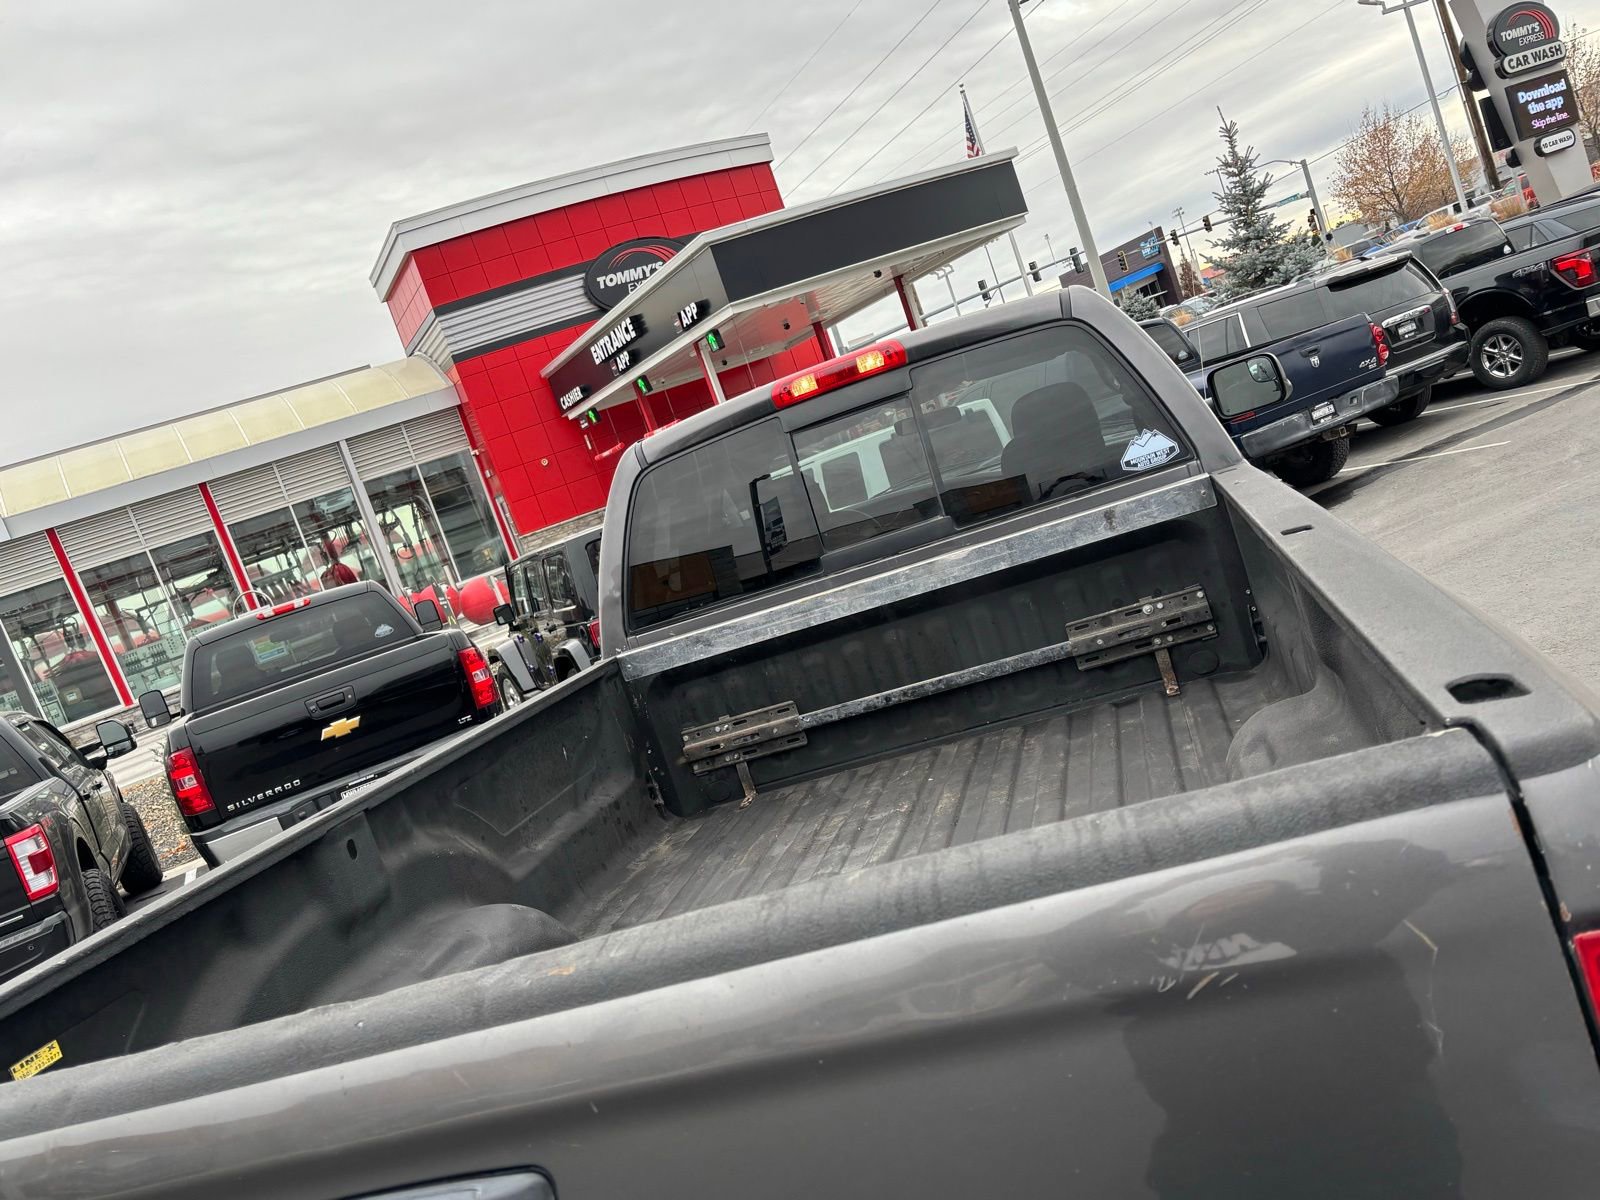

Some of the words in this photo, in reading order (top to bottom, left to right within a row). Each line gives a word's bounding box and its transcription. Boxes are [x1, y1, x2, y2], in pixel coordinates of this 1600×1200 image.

[1501, 22, 1539, 42] TOMMY'S
[1519, 32, 1545, 46] EXPRESS
[1508, 54, 1531, 70] CAR
[1531, 44, 1562, 63] WASH
[1517, 78, 1567, 104] Download
[1528, 101, 1545, 114] the
[1545, 95, 1564, 111] app
[1531, 118, 1547, 129] Skip
[1546, 115, 1557, 125] the
[1548, 139, 1559, 148] CAR
[1559, 135, 1573, 144] WASH
[596, 261, 664, 290] TOMMY'S
[680, 302, 698, 328] APP
[590, 316, 637, 366] ENTRANCE
[616, 350, 630, 372] APP
[560, 386, 584, 410] CASHIER
[227, 779, 301, 812] SILVERADO
